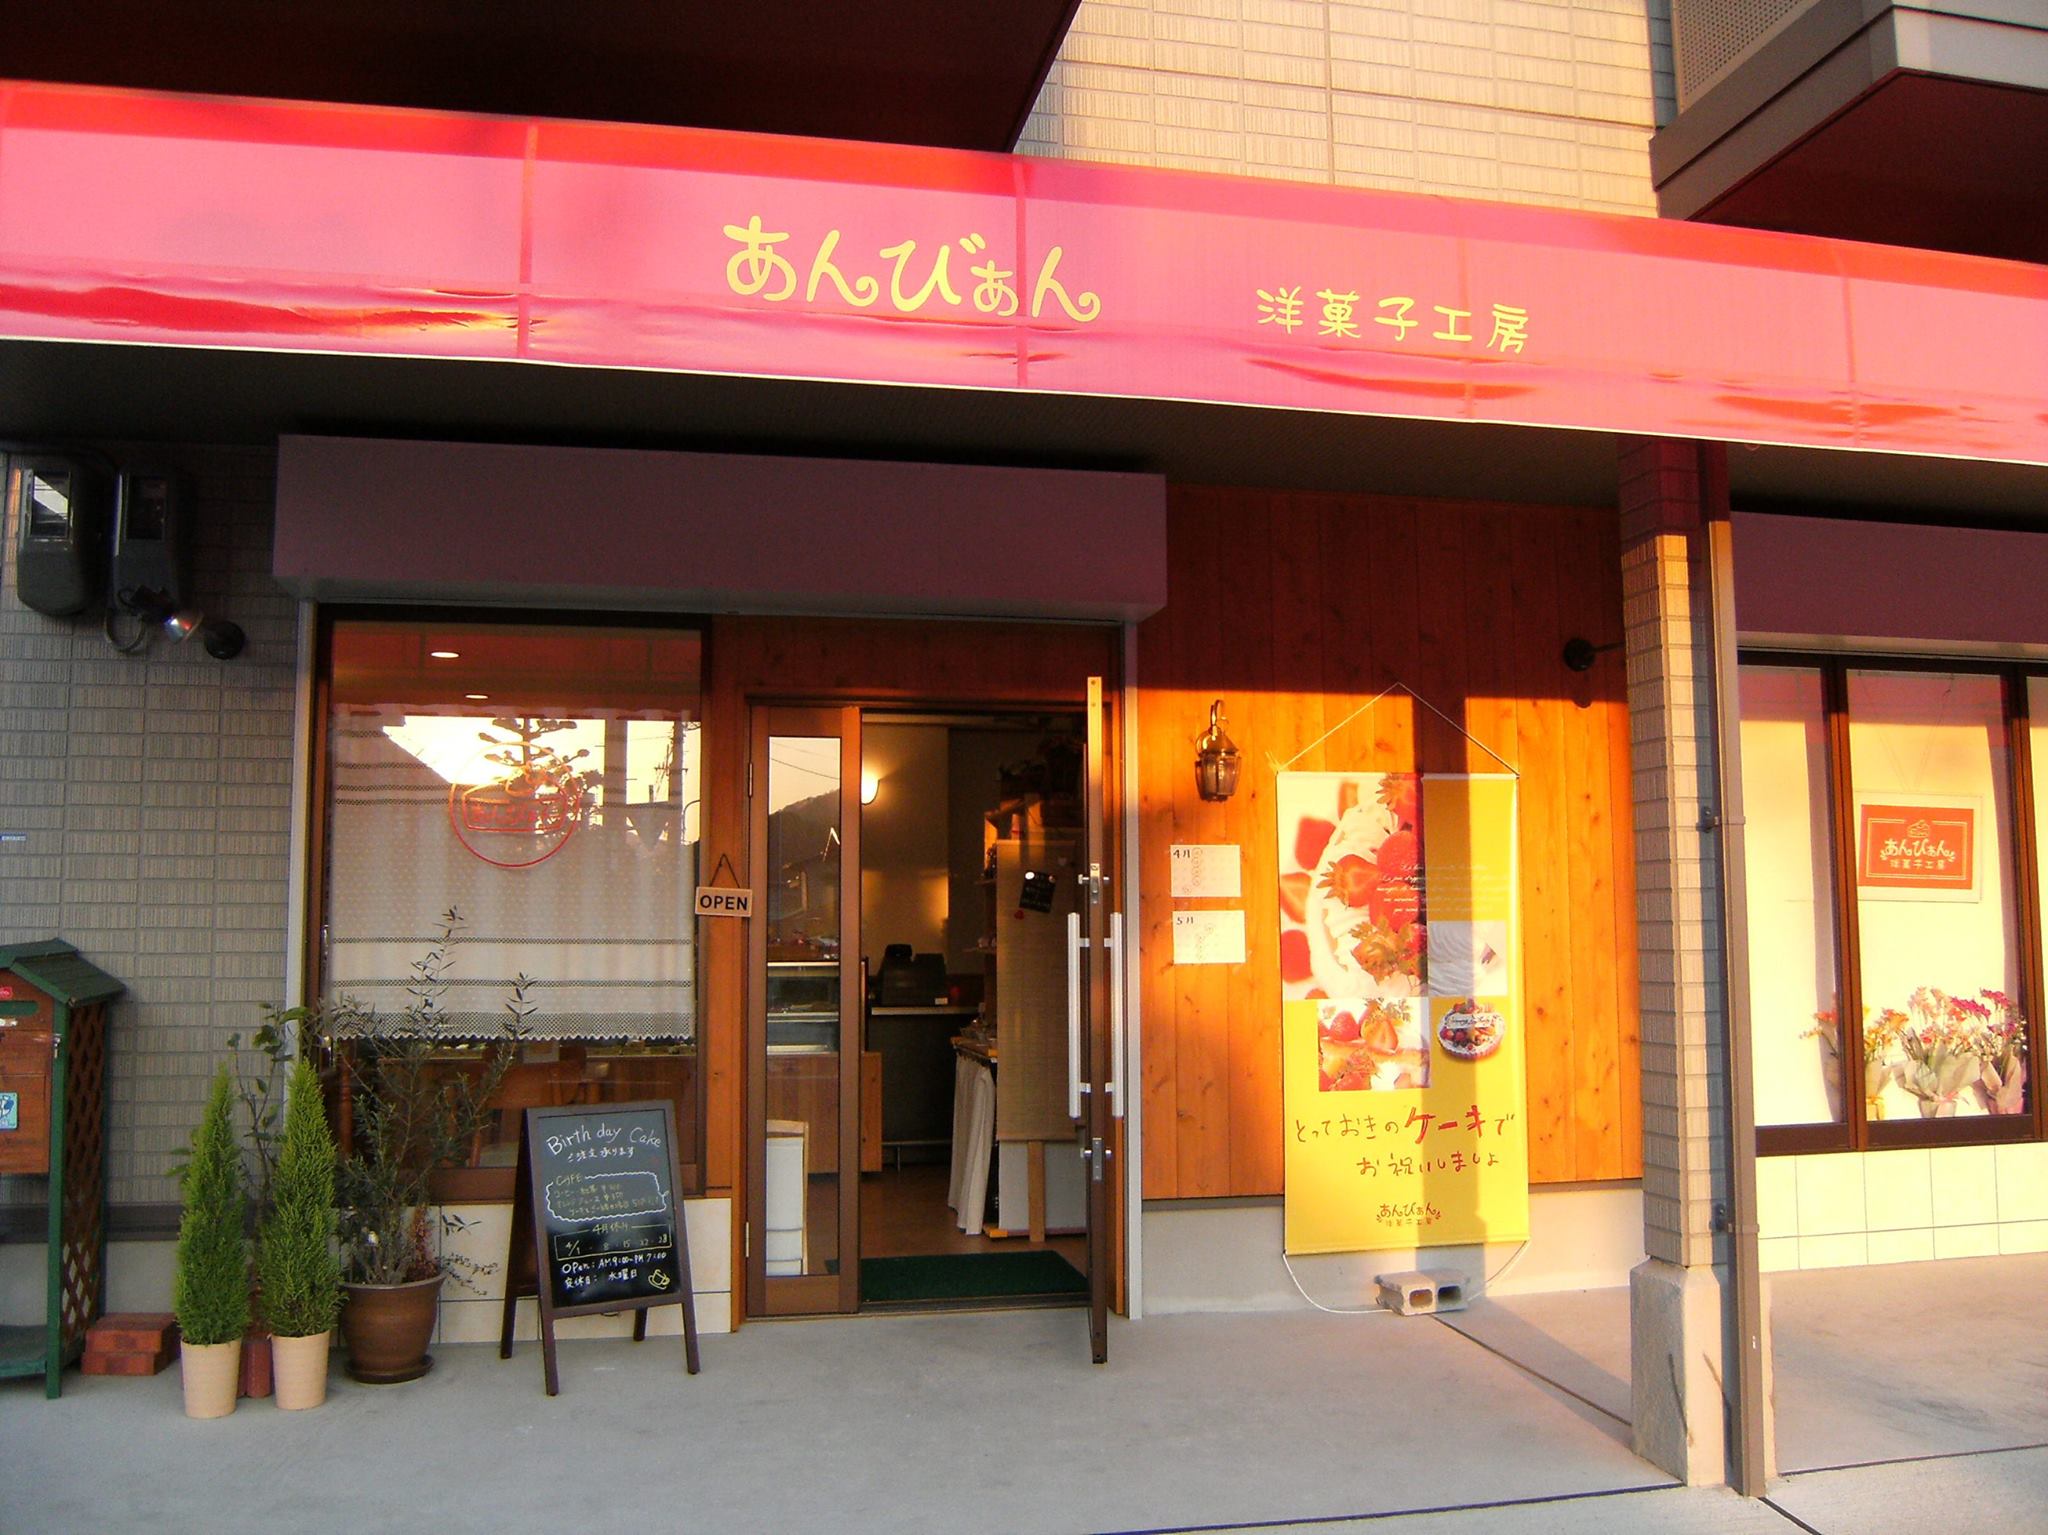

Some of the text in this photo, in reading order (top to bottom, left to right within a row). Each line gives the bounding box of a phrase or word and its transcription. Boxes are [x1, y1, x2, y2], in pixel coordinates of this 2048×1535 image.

[723, 215, 1101, 323] あんびぁん
[1256, 286, 1529, 354] 洋菓子工房
[700, 895, 748, 911] OPEN
[629, 1127, 662, 1148] Cake
[1295, 1105, 1516, 1145] とっておきのケーキで
